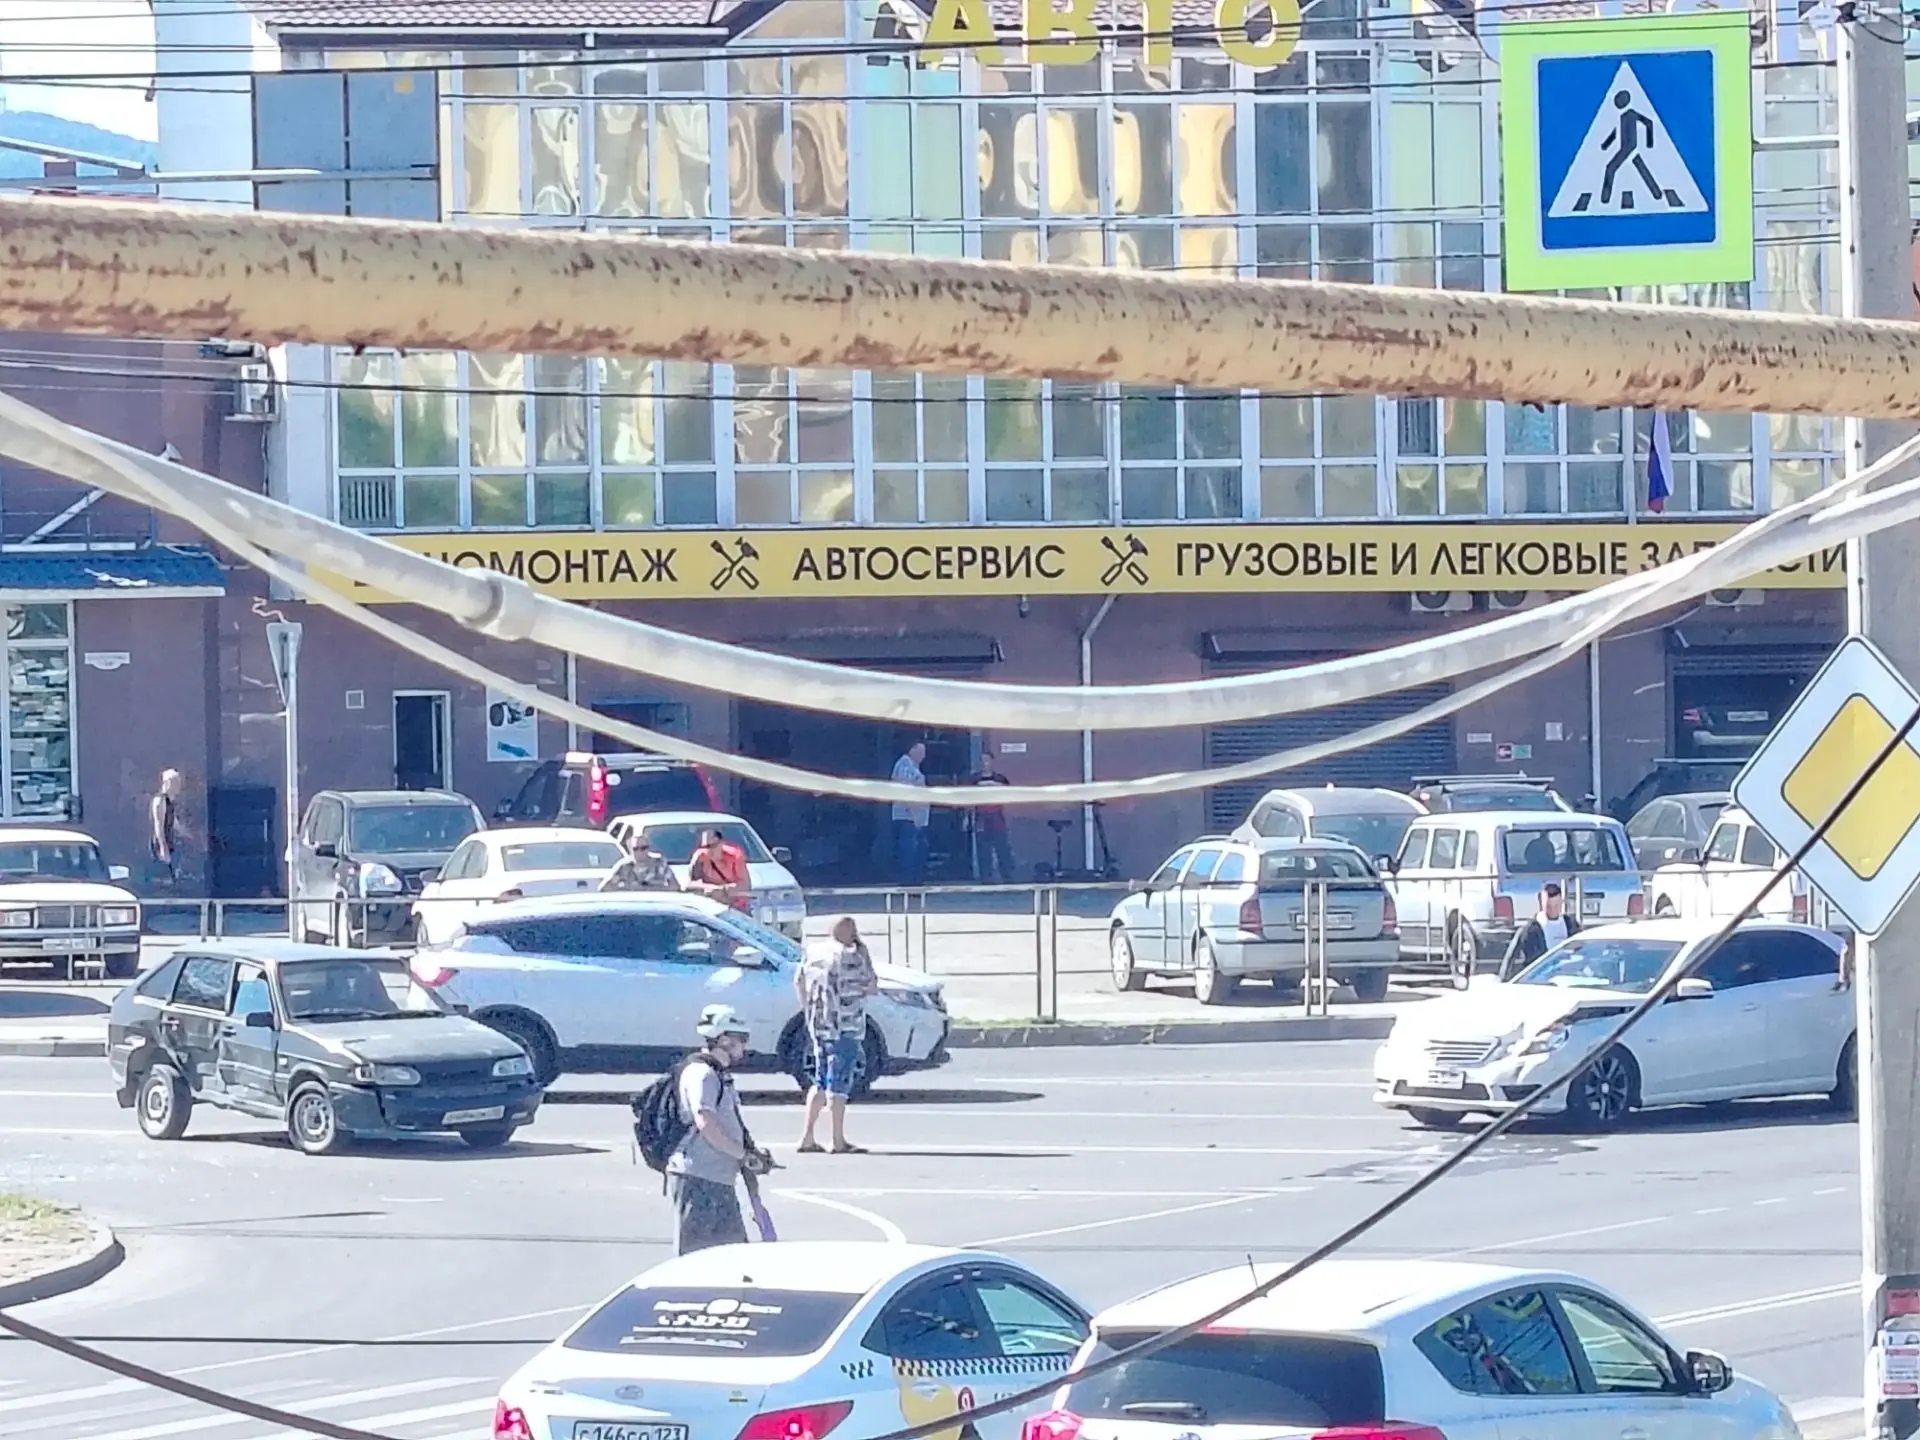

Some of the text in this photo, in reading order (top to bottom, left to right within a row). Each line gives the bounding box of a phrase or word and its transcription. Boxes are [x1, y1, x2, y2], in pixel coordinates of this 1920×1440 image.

[921, 0, 1302, 66] АВТО
[793, 545, 1065, 581] АВТОСЕРВИС
[1177, 542, 1378, 576] ГРУЗОВЫЕ
[1391, 542, 1417, 576] И
[1430, 542, 1627, 576] ЛЕГКОВЫЕ
